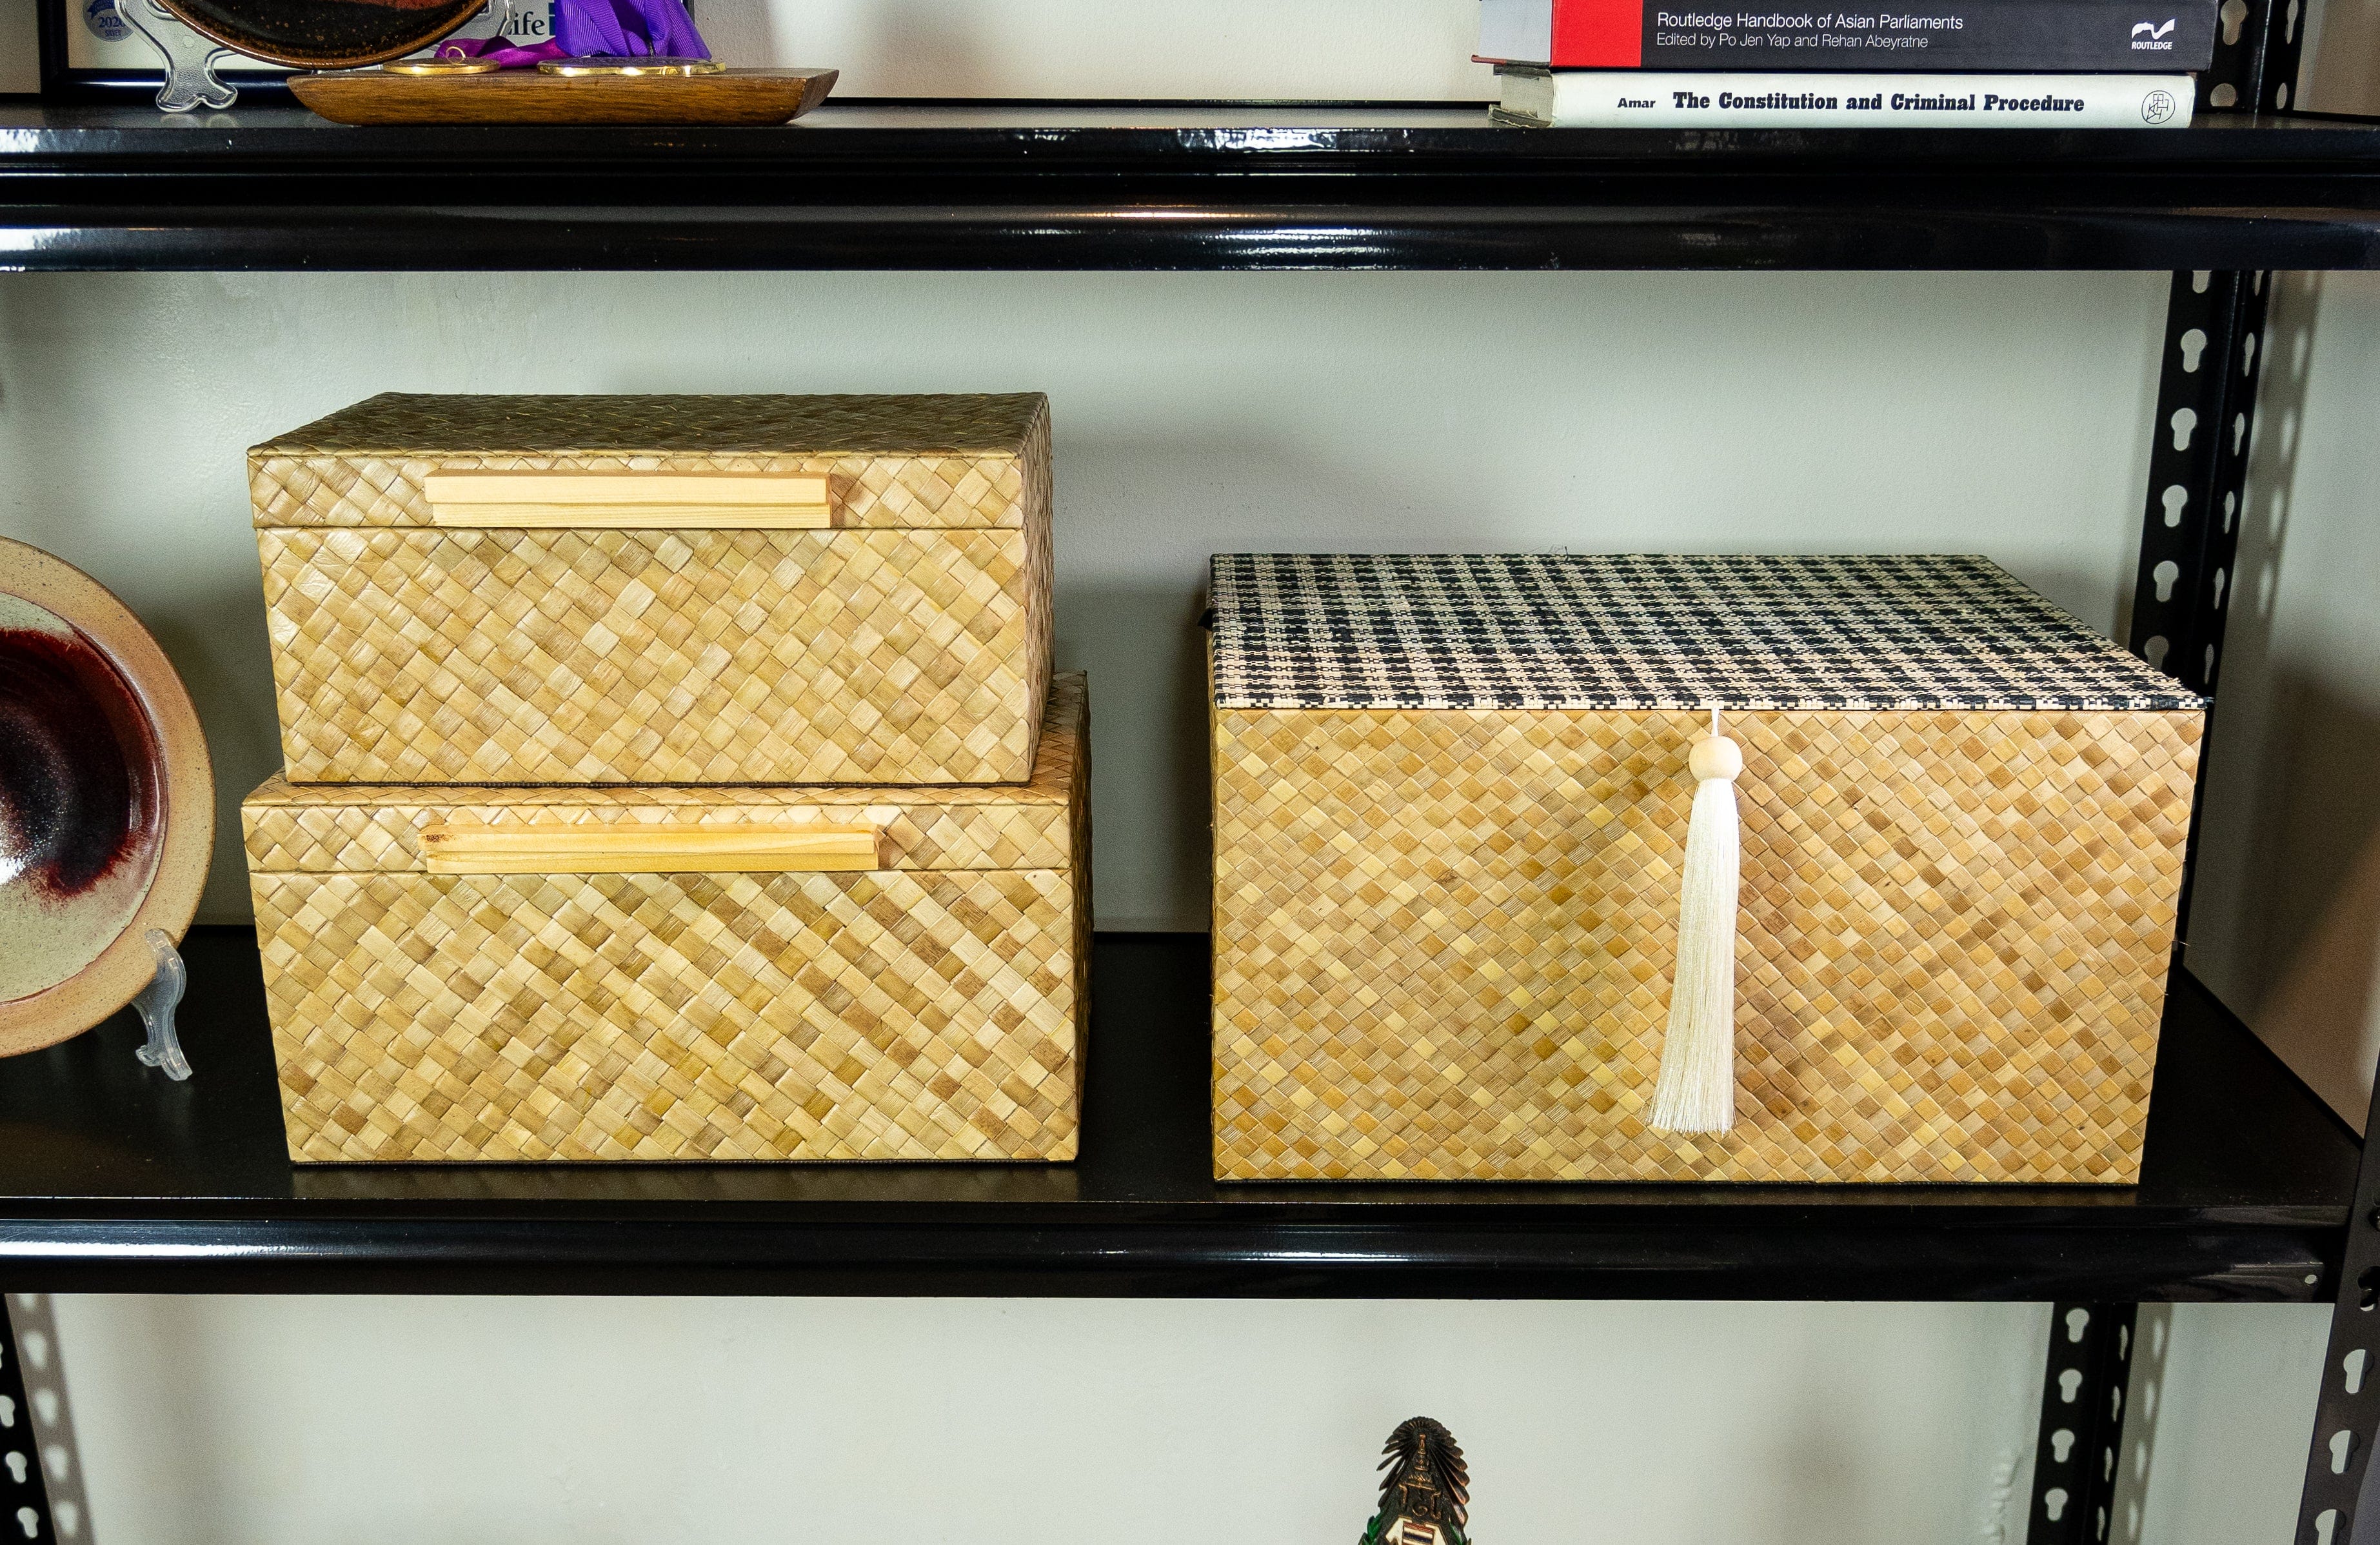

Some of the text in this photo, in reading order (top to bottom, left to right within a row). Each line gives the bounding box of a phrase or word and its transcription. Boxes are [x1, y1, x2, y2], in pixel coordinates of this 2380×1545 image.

[507, 10, 546, 35] ife
[1658, 12, 1963, 31] Routledge Handbook of Asian Parliaments
[1656, 32, 1929, 50] Edited by Po Jen Yap and Rehan Abeyratne
[2131, 41, 2173, 50] ROUTLEDGE
[1617, 97, 1656, 108] Amar
[1672, 92, 2085, 112] The Constitution and Criminal Procedure
